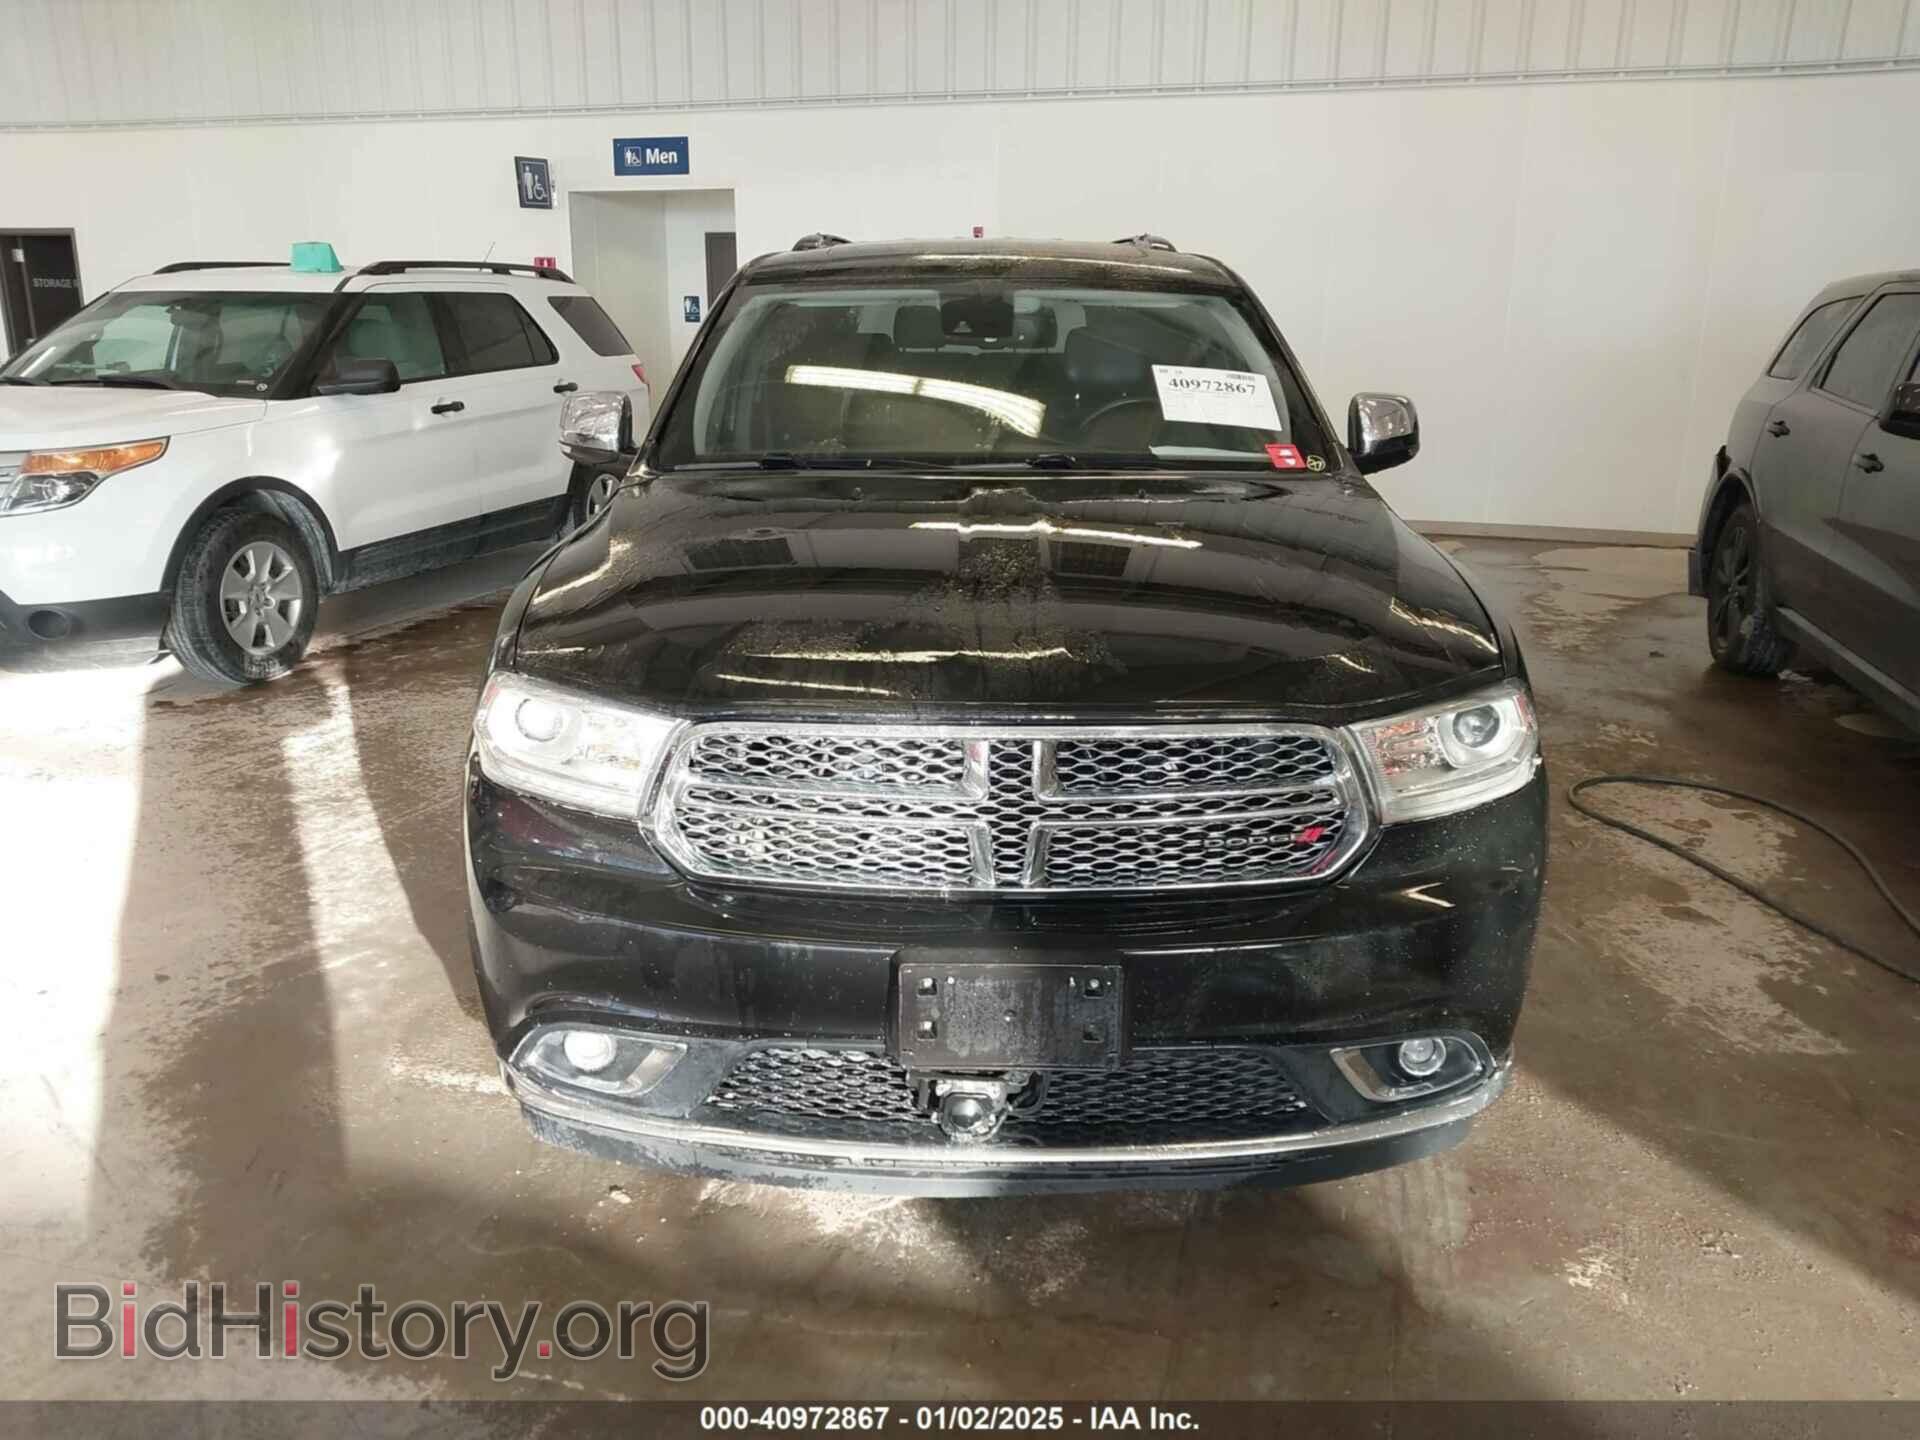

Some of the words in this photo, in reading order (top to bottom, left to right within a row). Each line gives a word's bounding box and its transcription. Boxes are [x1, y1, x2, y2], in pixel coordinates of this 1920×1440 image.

[645, 148, 678, 165] Men
[33, 278, 72, 288] STORAGE
[1168, 377, 1256, 395] 40972867
